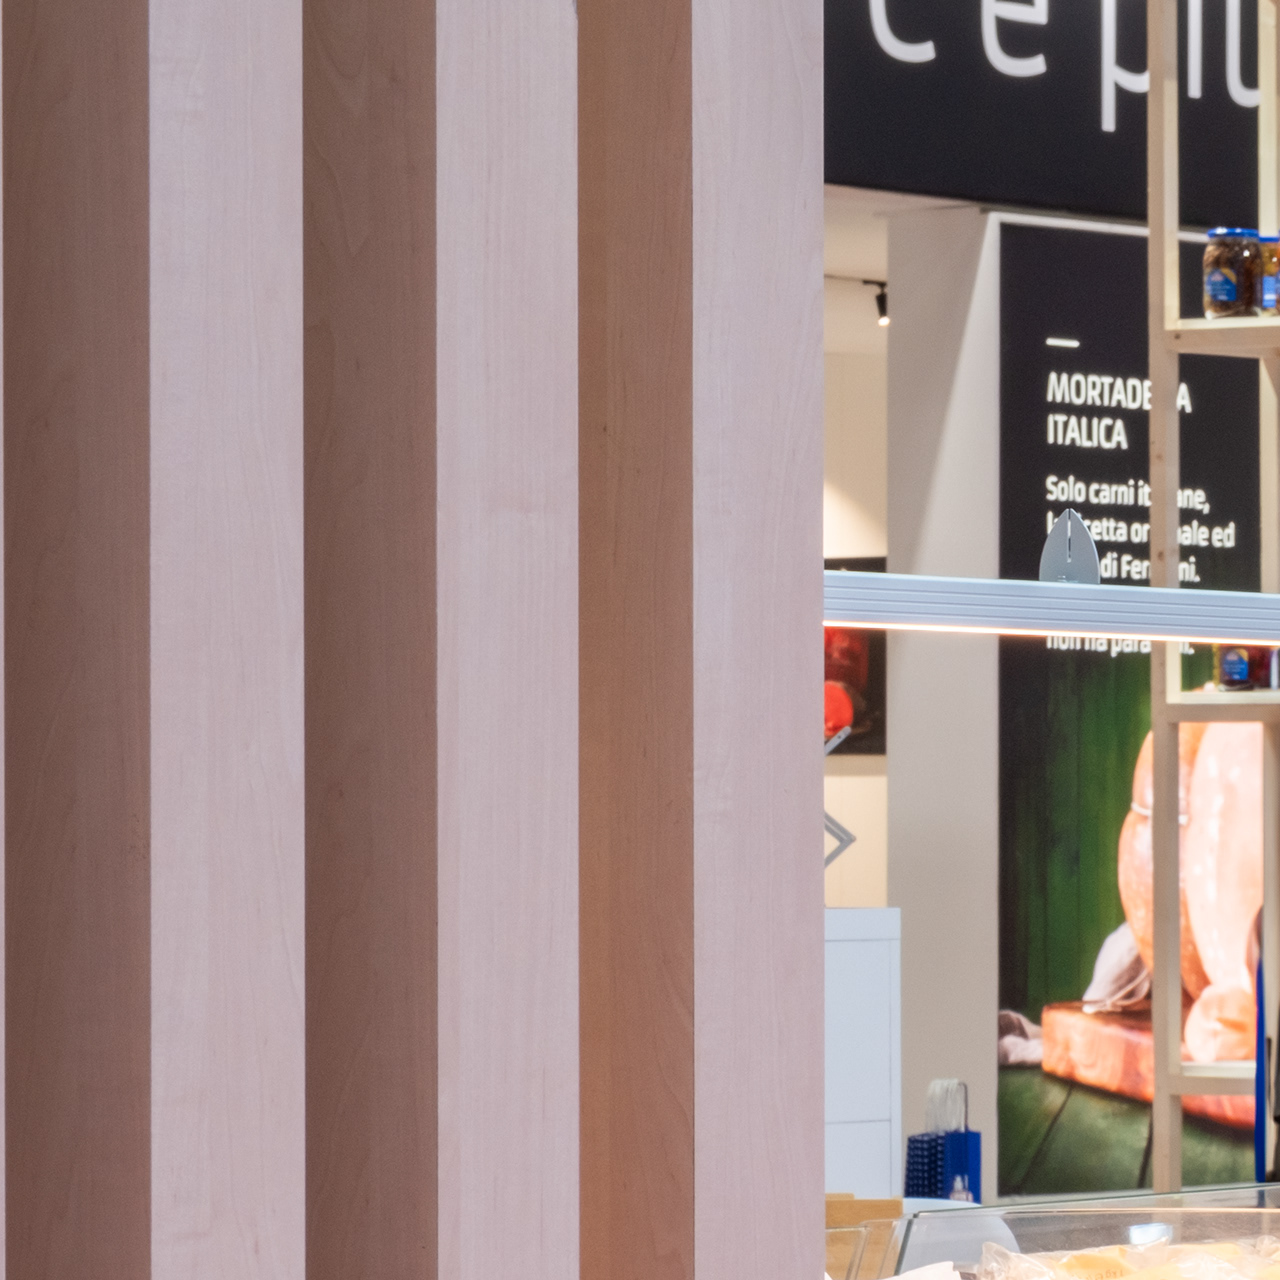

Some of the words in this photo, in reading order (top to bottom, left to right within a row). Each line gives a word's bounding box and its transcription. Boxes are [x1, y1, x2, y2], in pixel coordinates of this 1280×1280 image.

[1046, 371, 1192, 414] MORTADEA
[1046, 413, 1128, 450] ITALICA
[1046, 475, 1086, 503] Solo
[1088, 479, 1135, 506] carni
[1137, 479, 1210, 515] itne,
[1130, 519, 1209, 547] orale
[1211, 521, 1236, 548] ed
[1100, 552, 1118, 579] di
[1120, 554, 1201, 583] Ferni.
